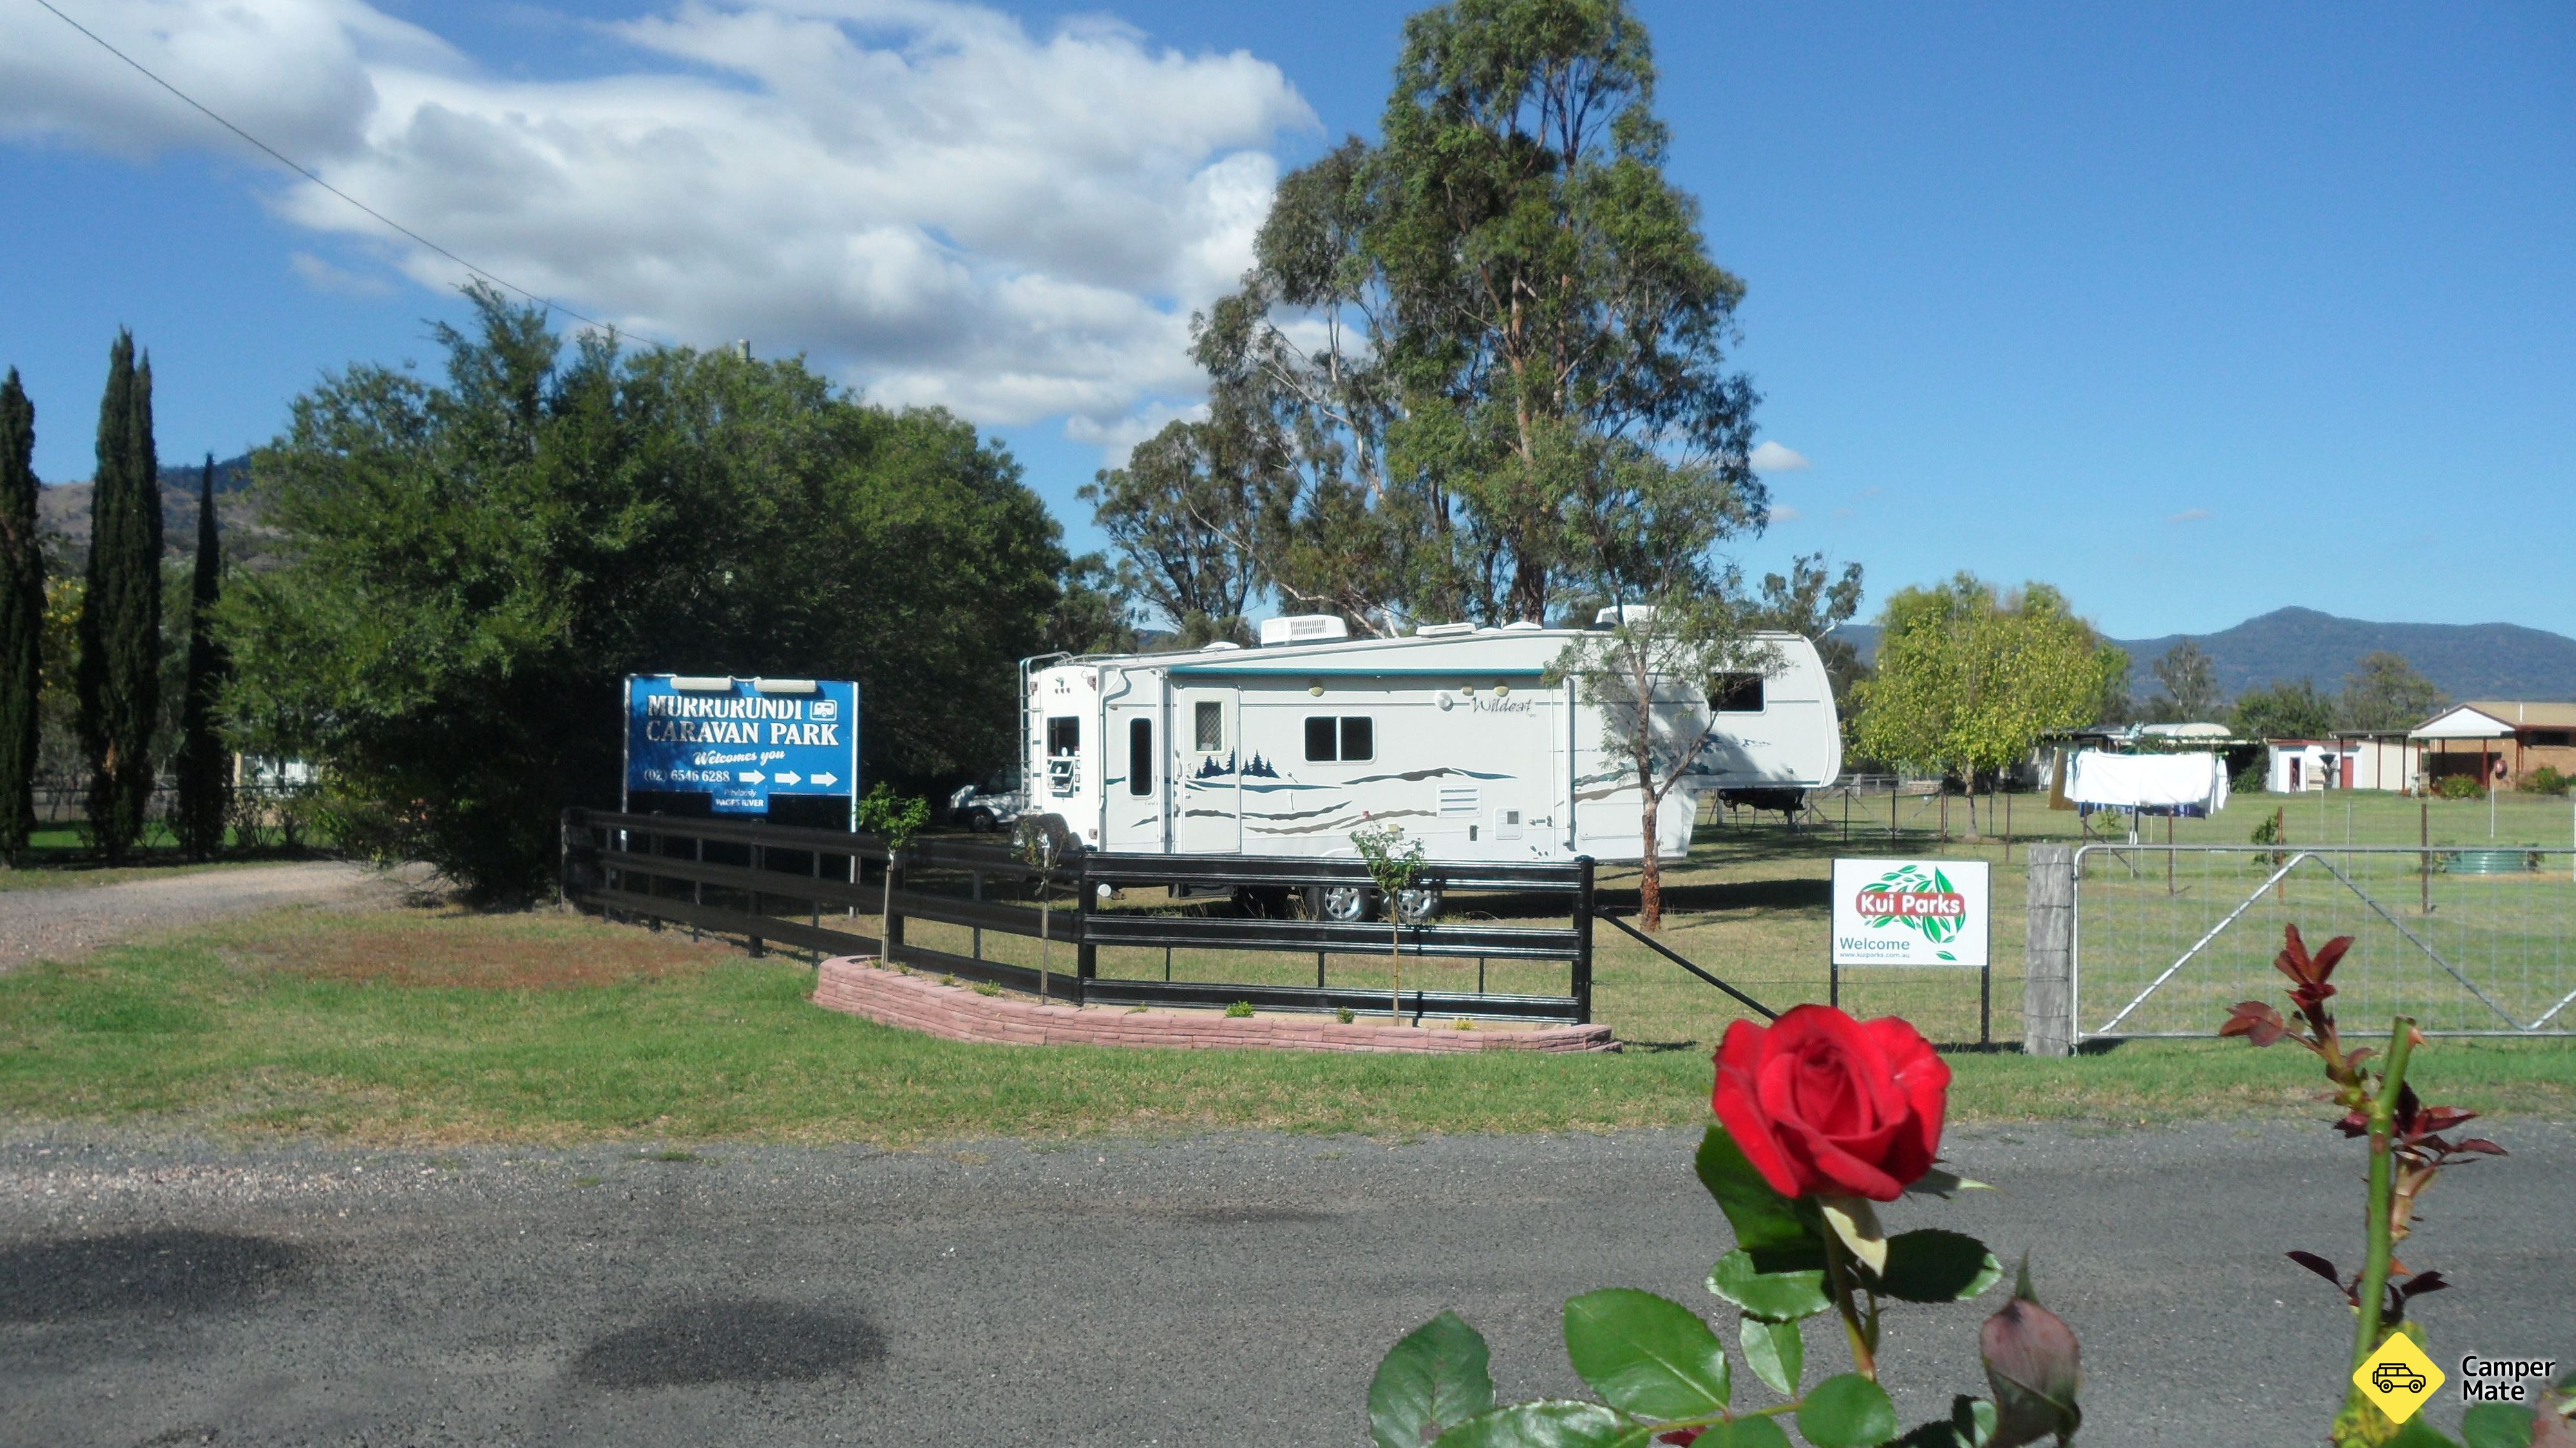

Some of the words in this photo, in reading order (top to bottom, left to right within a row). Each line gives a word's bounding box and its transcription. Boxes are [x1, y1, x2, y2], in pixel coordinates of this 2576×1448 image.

[648, 695, 802, 720] MURRURUNDI
[1472, 697, 1533, 714] Wildcat
[646, 720, 759, 744] CARAVAN
[770, 722, 839, 746] PARK
[693, 750, 757, 765] Welcomes
[761, 750, 785, 767] you
[670, 769, 699, 782] 6546
[702, 770, 730, 782] 6288
[1861, 893, 1895, 913] Kui
[1902, 894, 1960, 913] Parks
[1840, 937, 1910, 950] Welcome
